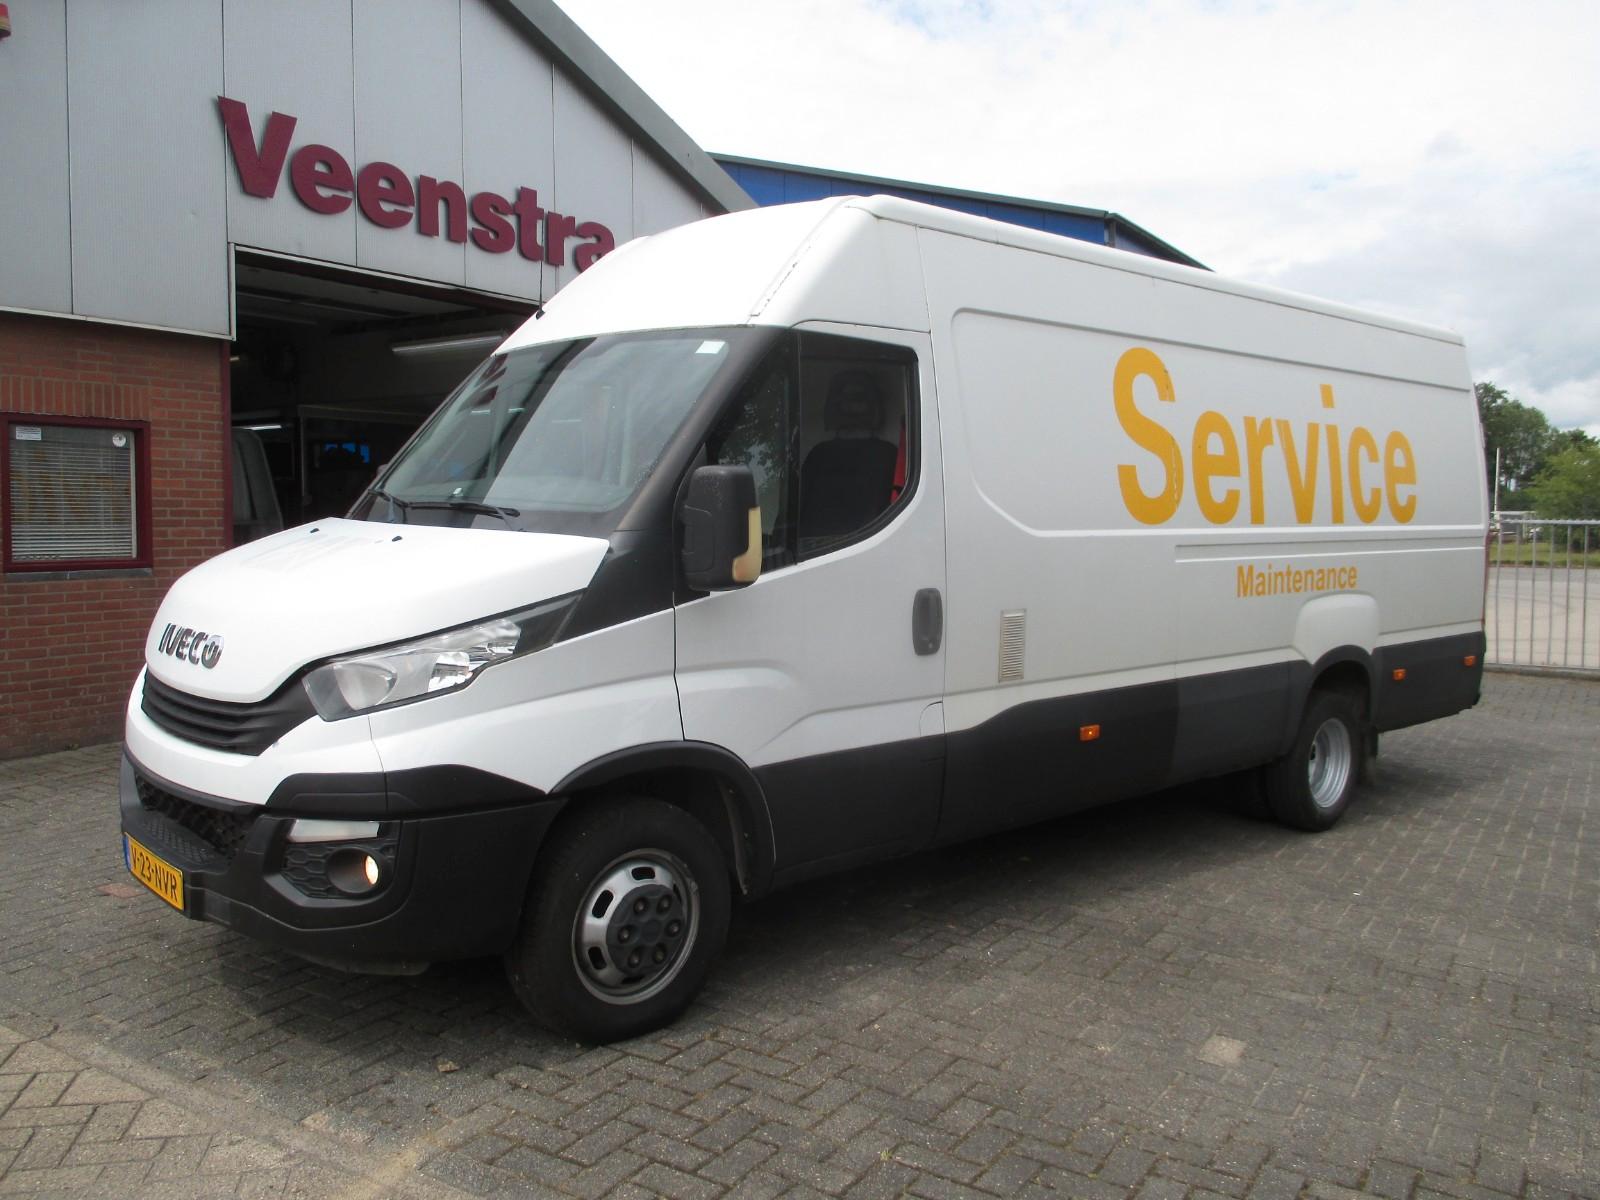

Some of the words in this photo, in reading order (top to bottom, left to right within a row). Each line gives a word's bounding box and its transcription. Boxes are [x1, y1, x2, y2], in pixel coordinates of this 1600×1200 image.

[218, 95, 615, 274] Veenstra
[1113, 347, 1417, 525] Service
[1236, 563, 1358, 598] Maintenance
[158, 622, 224, 669] IVECO
